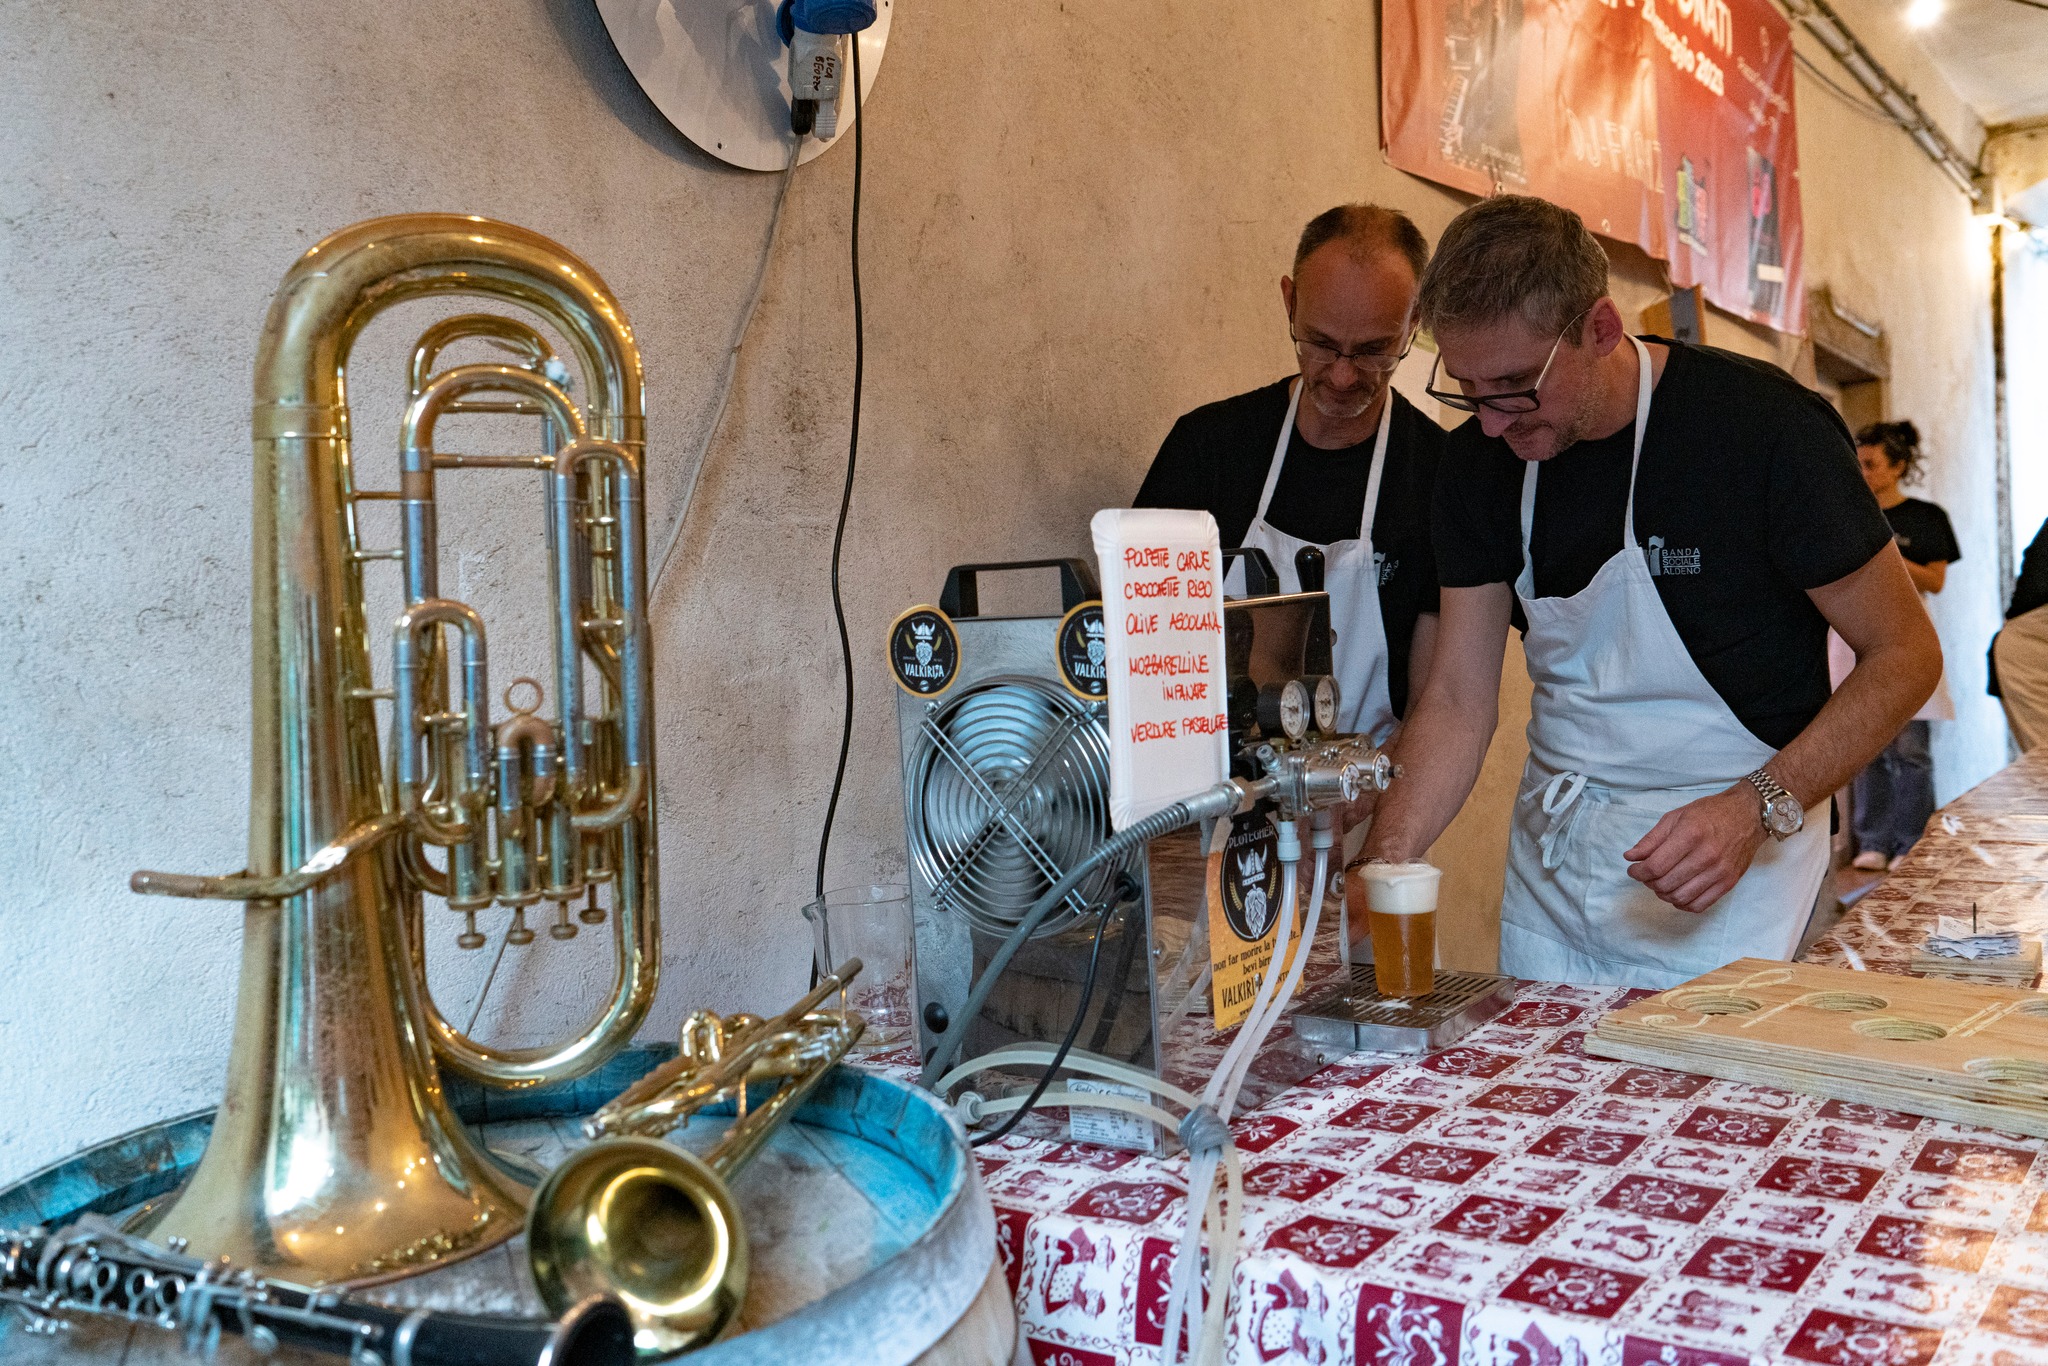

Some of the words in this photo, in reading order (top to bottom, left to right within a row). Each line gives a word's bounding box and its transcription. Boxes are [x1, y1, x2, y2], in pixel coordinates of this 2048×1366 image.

[1123, 547, 1170, 569] POLPETTE
[1176, 550, 1211, 572] CARNE
[1662, 547, 1700, 557] BANDA
[1662, 557, 1700, 566] SOCIALE
[1663, 567, 1701, 575] ALDENO
[1124, 576, 1181, 600] CROCCHETTE
[1169, 611, 1223, 634] ASCOLANA
[1074, 661, 1107, 679] VALKIR
[1128, 651, 1209, 677] MOZZARELLINE
[1130, 720, 1178, 743] VERDURE
[1213, 960, 1227, 973] non
[1228, 954, 1239, 966] far
[1240, 944, 1262, 961] morire
[1263, 940, 1271, 951] la
[1242, 960, 1258, 975] bevi
[1259, 956, 1272, 969] birr
